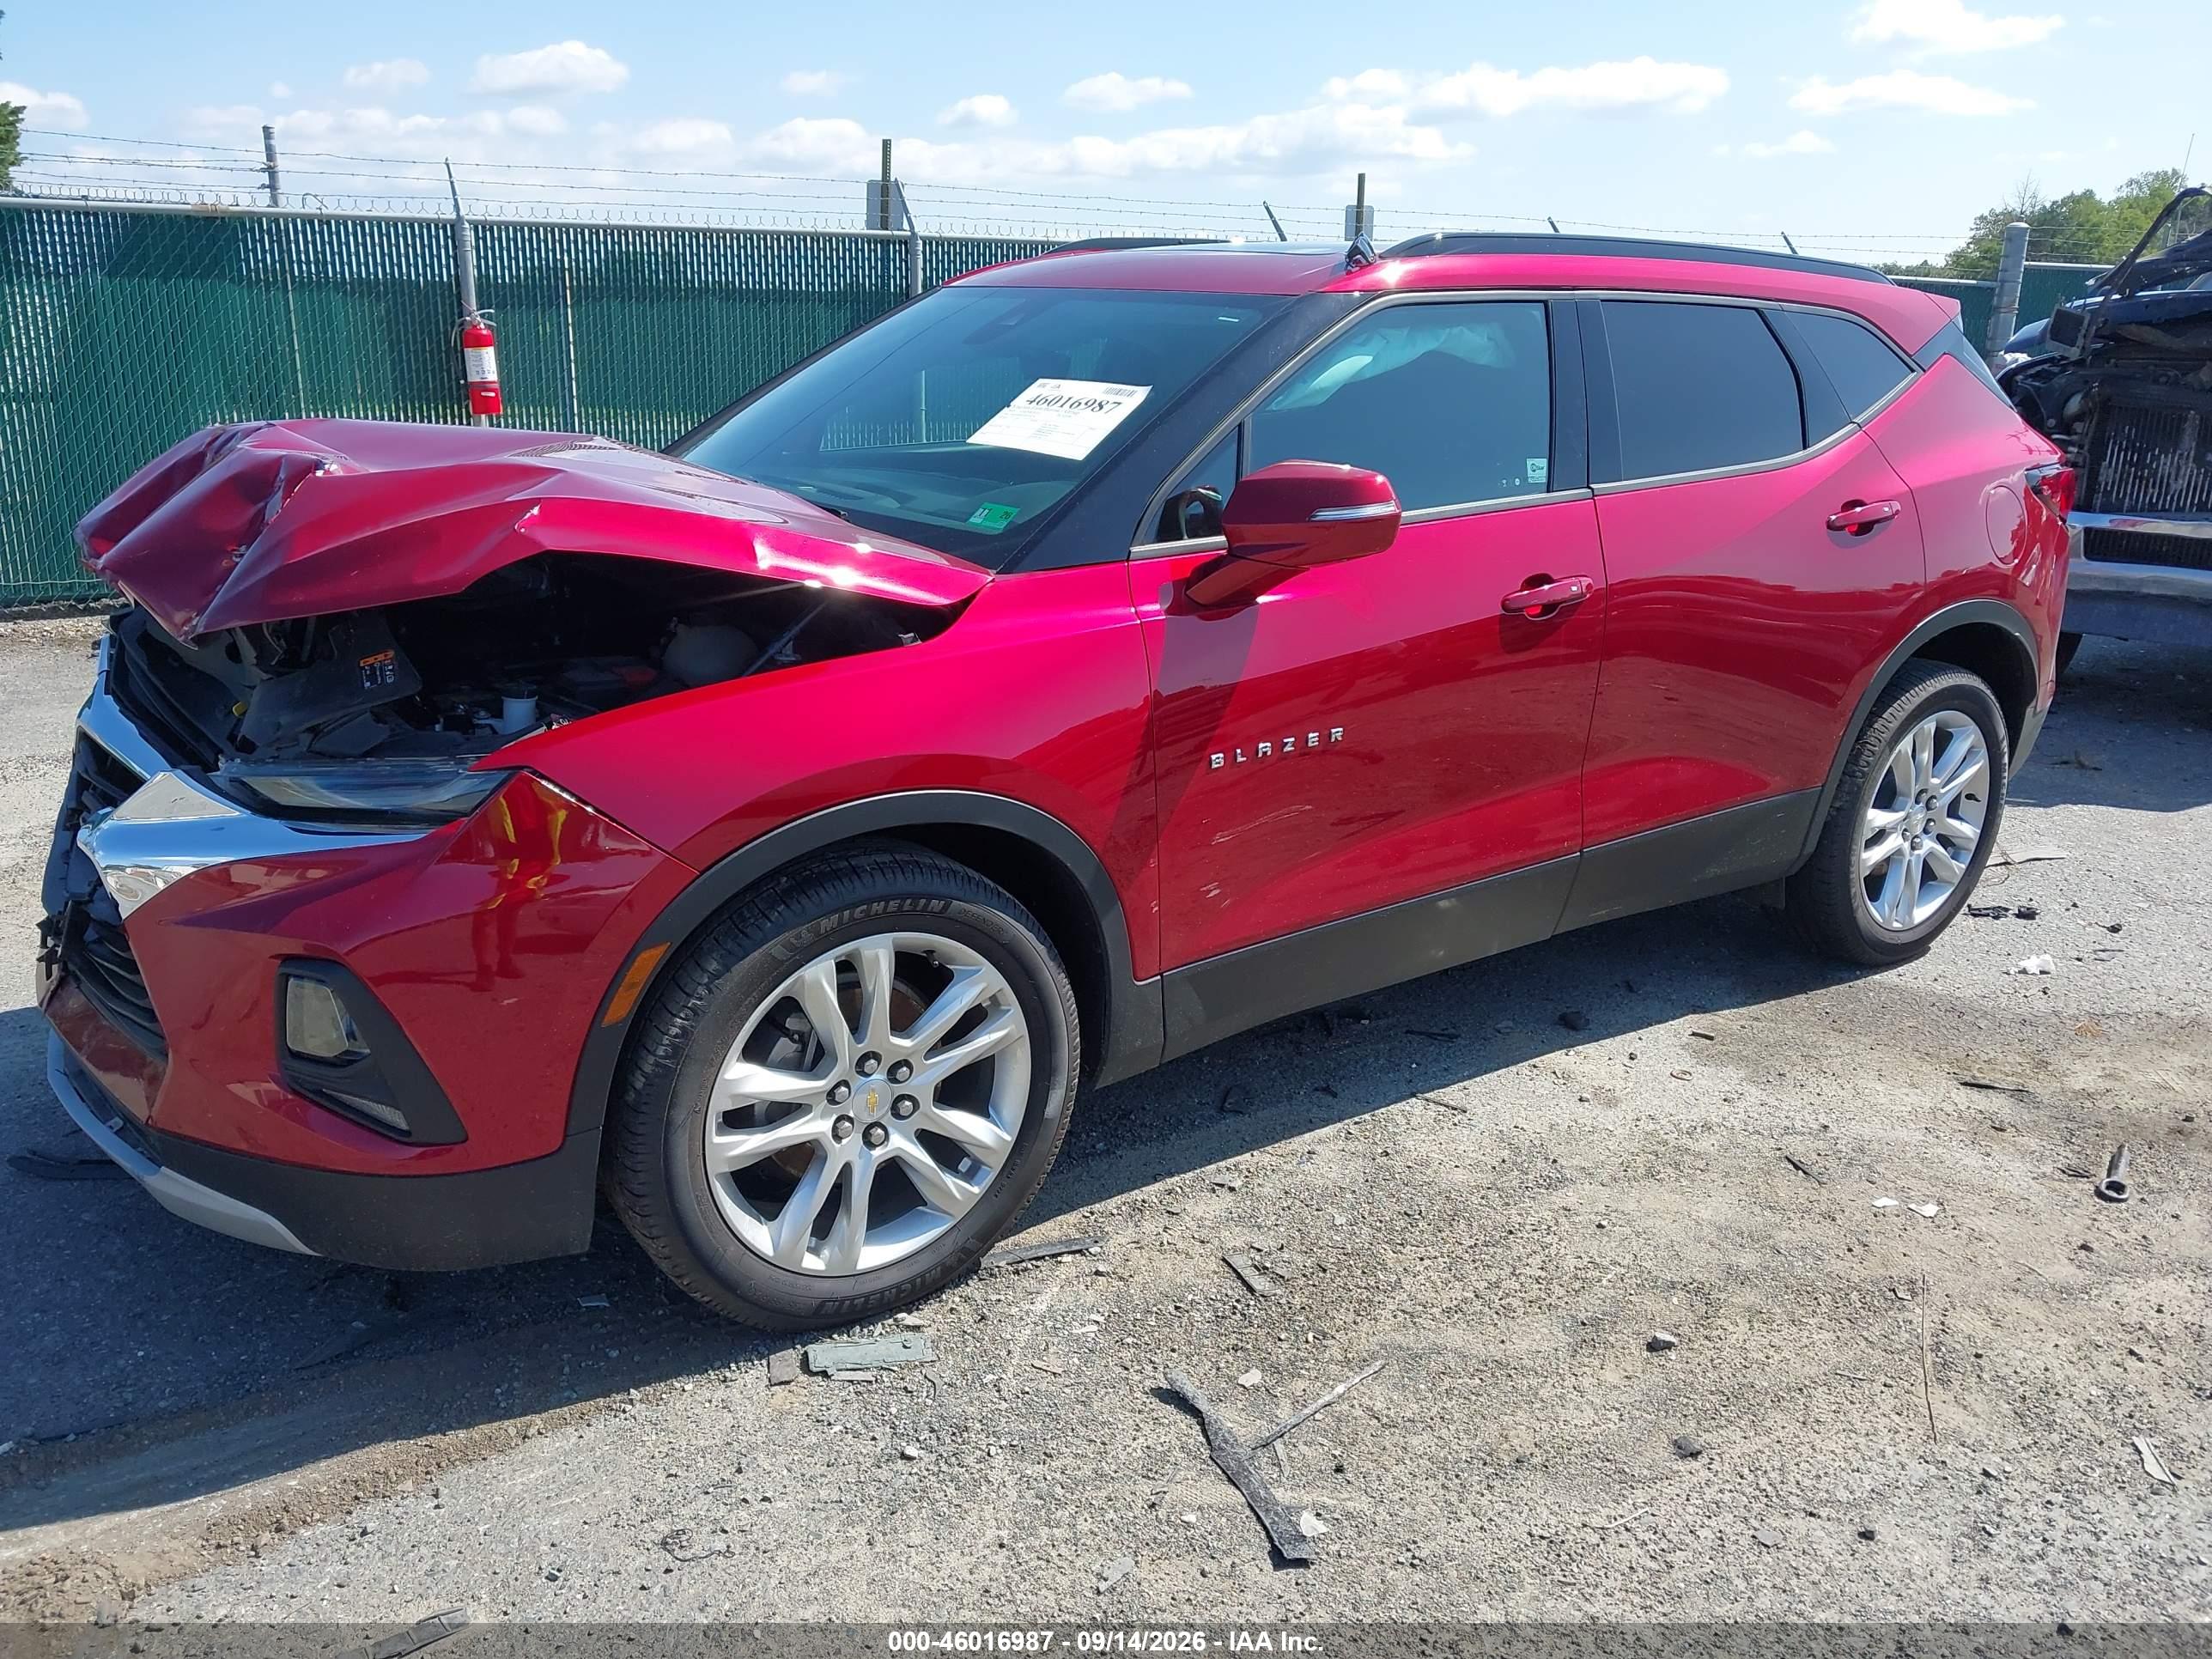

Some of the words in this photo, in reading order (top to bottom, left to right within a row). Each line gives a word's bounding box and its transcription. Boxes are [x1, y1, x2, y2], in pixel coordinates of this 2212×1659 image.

[1025, 393, 1122, 414] 46016987
[1210, 727, 1344, 769] BLAZER
[819, 897, 945, 935] MICHELIN
